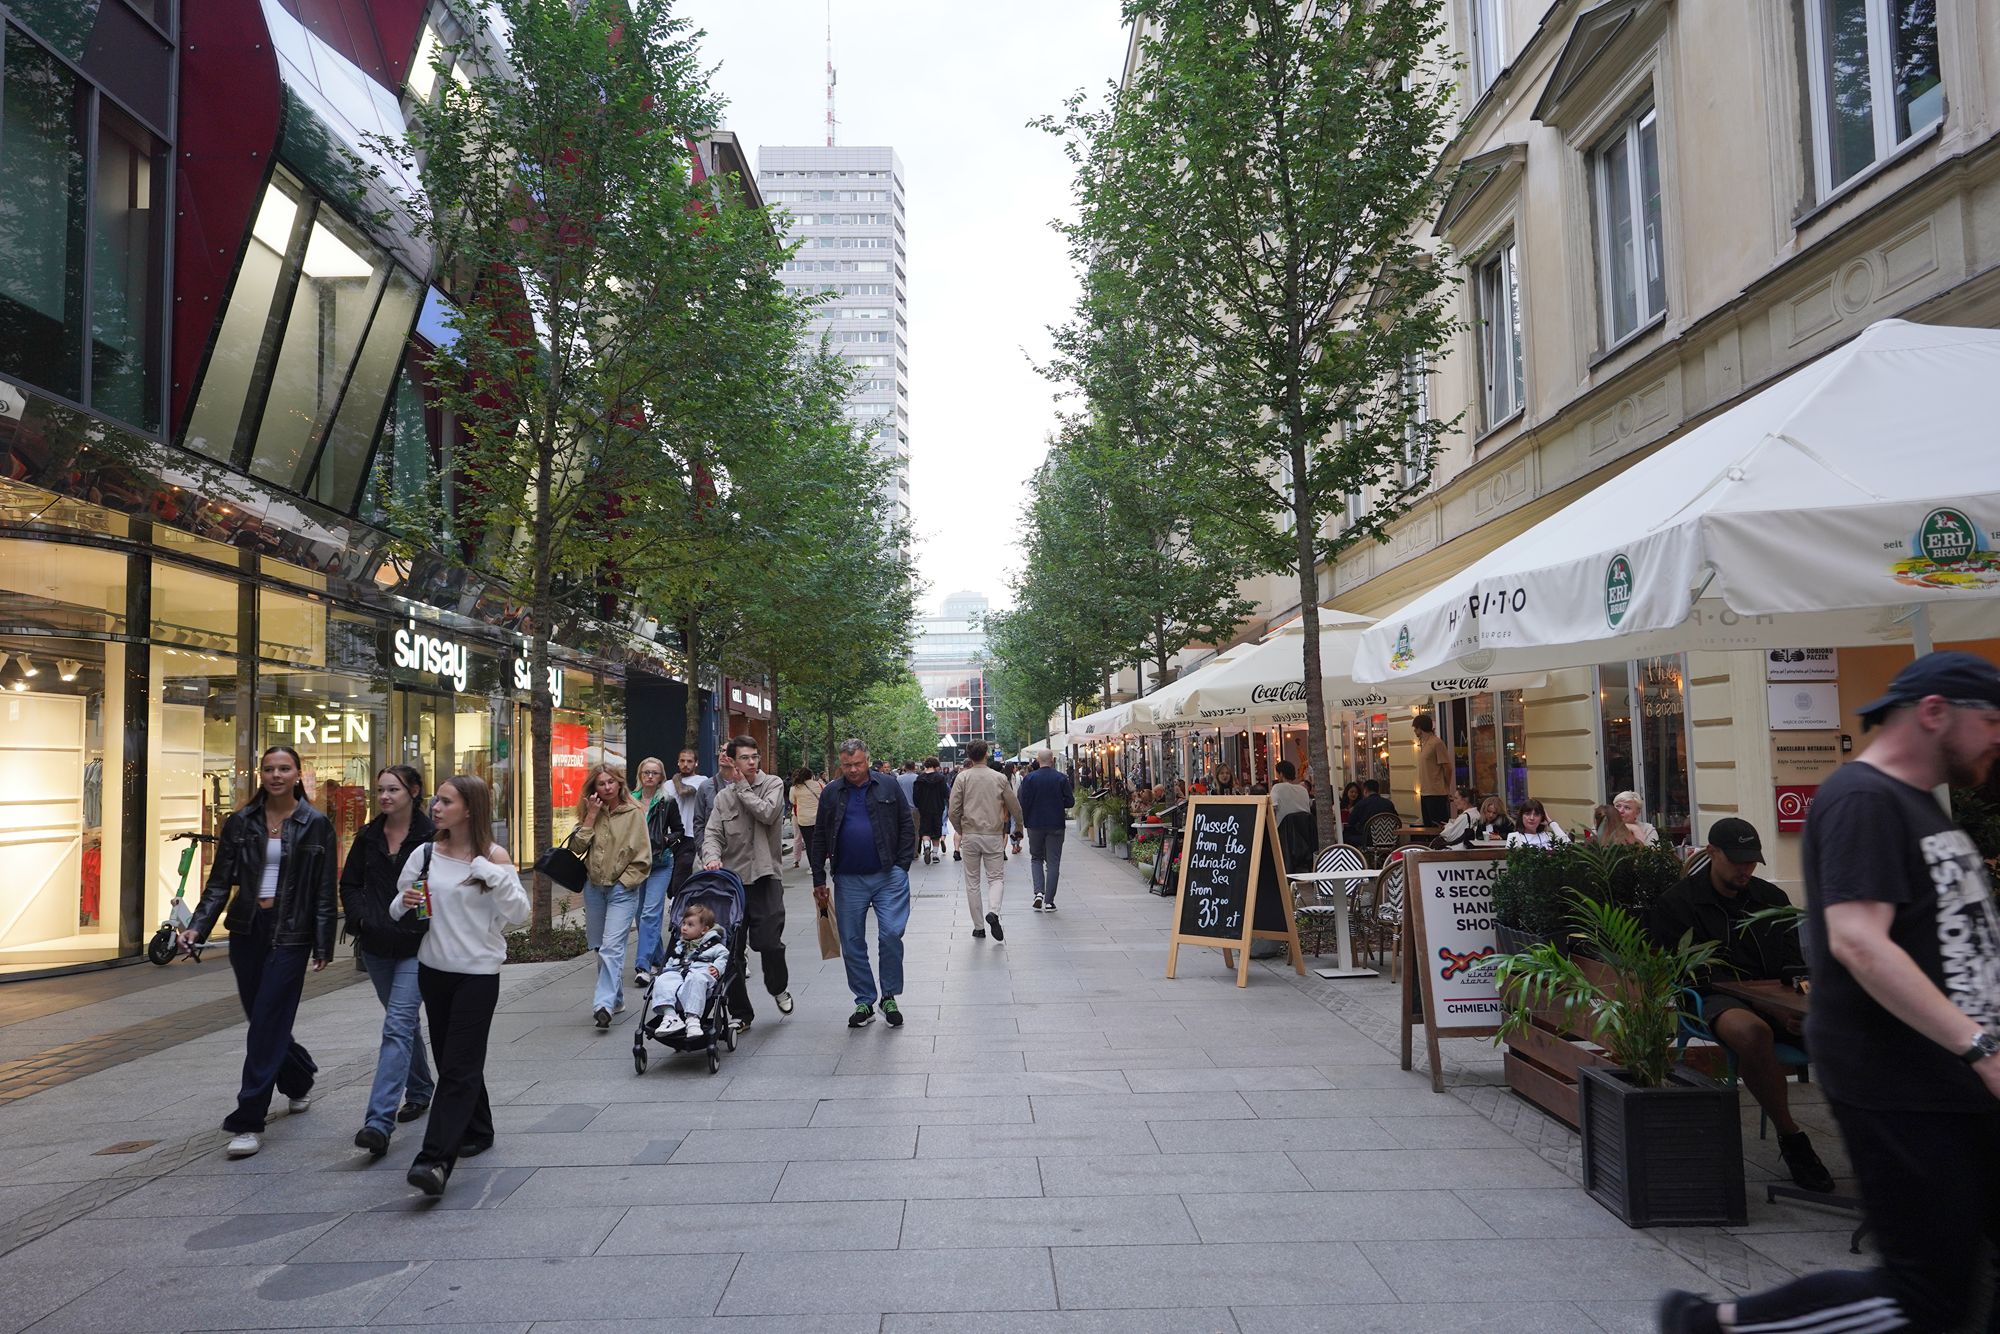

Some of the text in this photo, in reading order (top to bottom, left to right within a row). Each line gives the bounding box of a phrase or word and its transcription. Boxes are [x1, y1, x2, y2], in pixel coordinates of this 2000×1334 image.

[1883, 540, 1903, 549] seit
[1926, 531, 1971, 549] ERL
[1608, 584, 1631, 604] ERL
[394, 618, 467, 692] sinsay
[514, 641, 562, 708] siay
[1251, 681, 1308, 704] Coca-Cola
[1194, 813, 1240, 834] Mussels
[1195, 833, 1246, 854] from the
[1190, 854, 1237, 871] Adriatic
[1211, 868, 1230, 886] Sea
[1189, 880, 1213, 896] from
[1435, 887, 1446, 899] &
